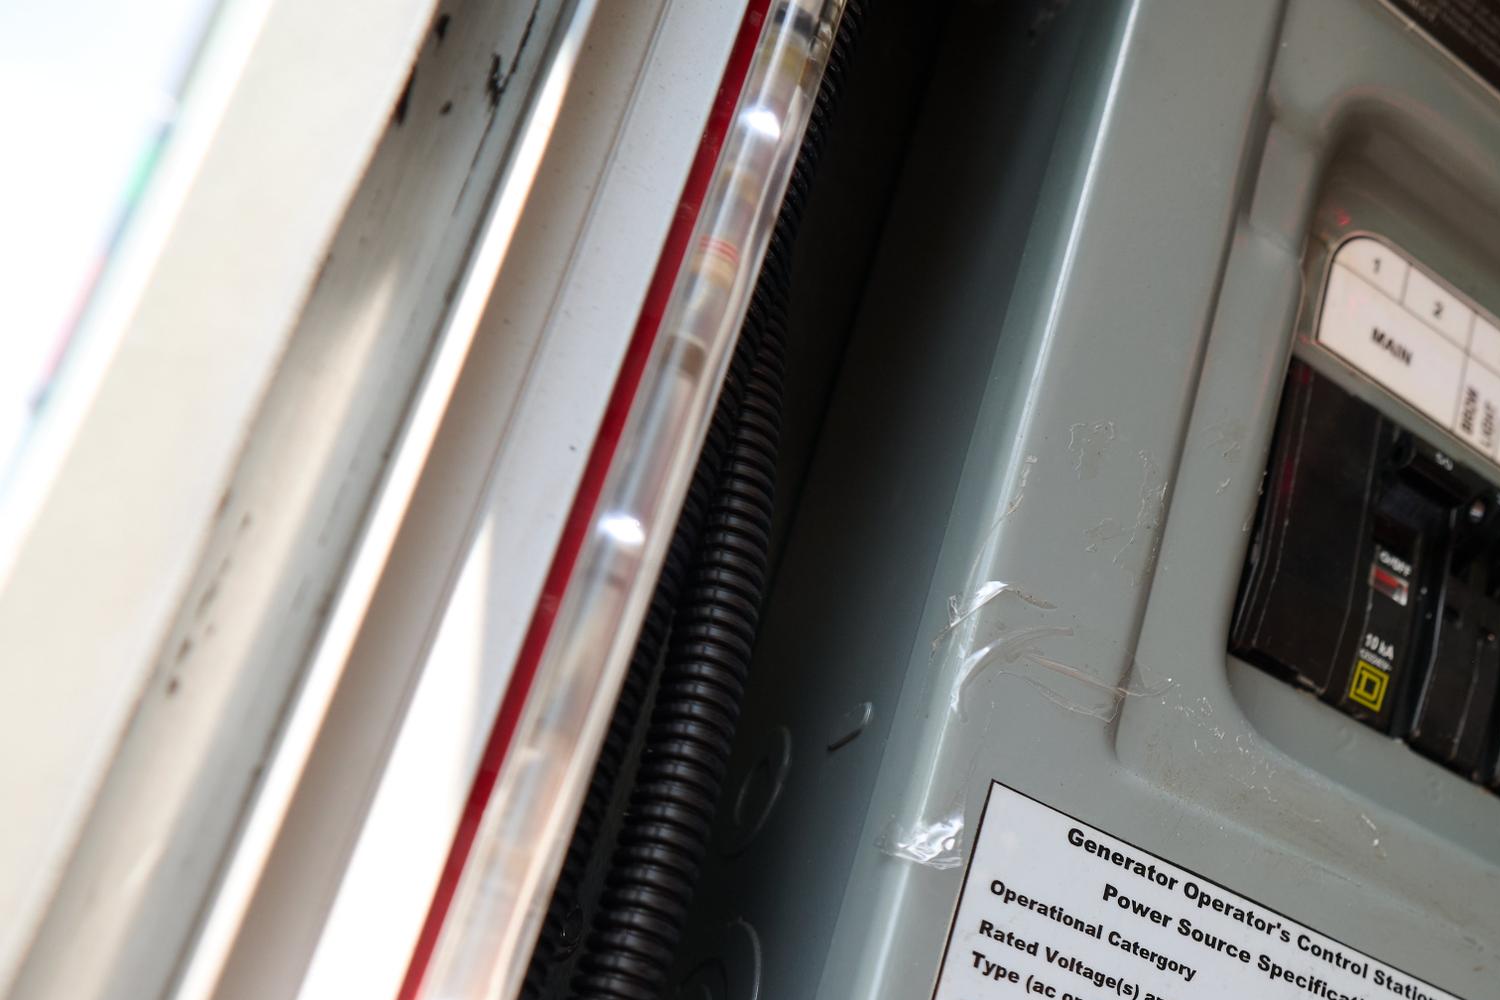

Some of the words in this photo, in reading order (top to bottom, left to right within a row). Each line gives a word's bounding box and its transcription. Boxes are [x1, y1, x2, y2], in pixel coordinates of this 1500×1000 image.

[1370, 327, 1414, 366] MAIN
[990, 880, 1103, 940] Operational
[1108, 931, 1197, 982] Catergory
[1068, 828, 1179, 890] Generator
[1184, 882, 1290, 943] Operator's
[1297, 935, 1368, 979] Control
[1102, 883, 1173, 928] Power
[1177, 918, 1251, 963] Source
[979, 919, 1039, 957] Rated
[972, 950, 1020, 983] Type
[1026, 975, 1056, 998] (ac
